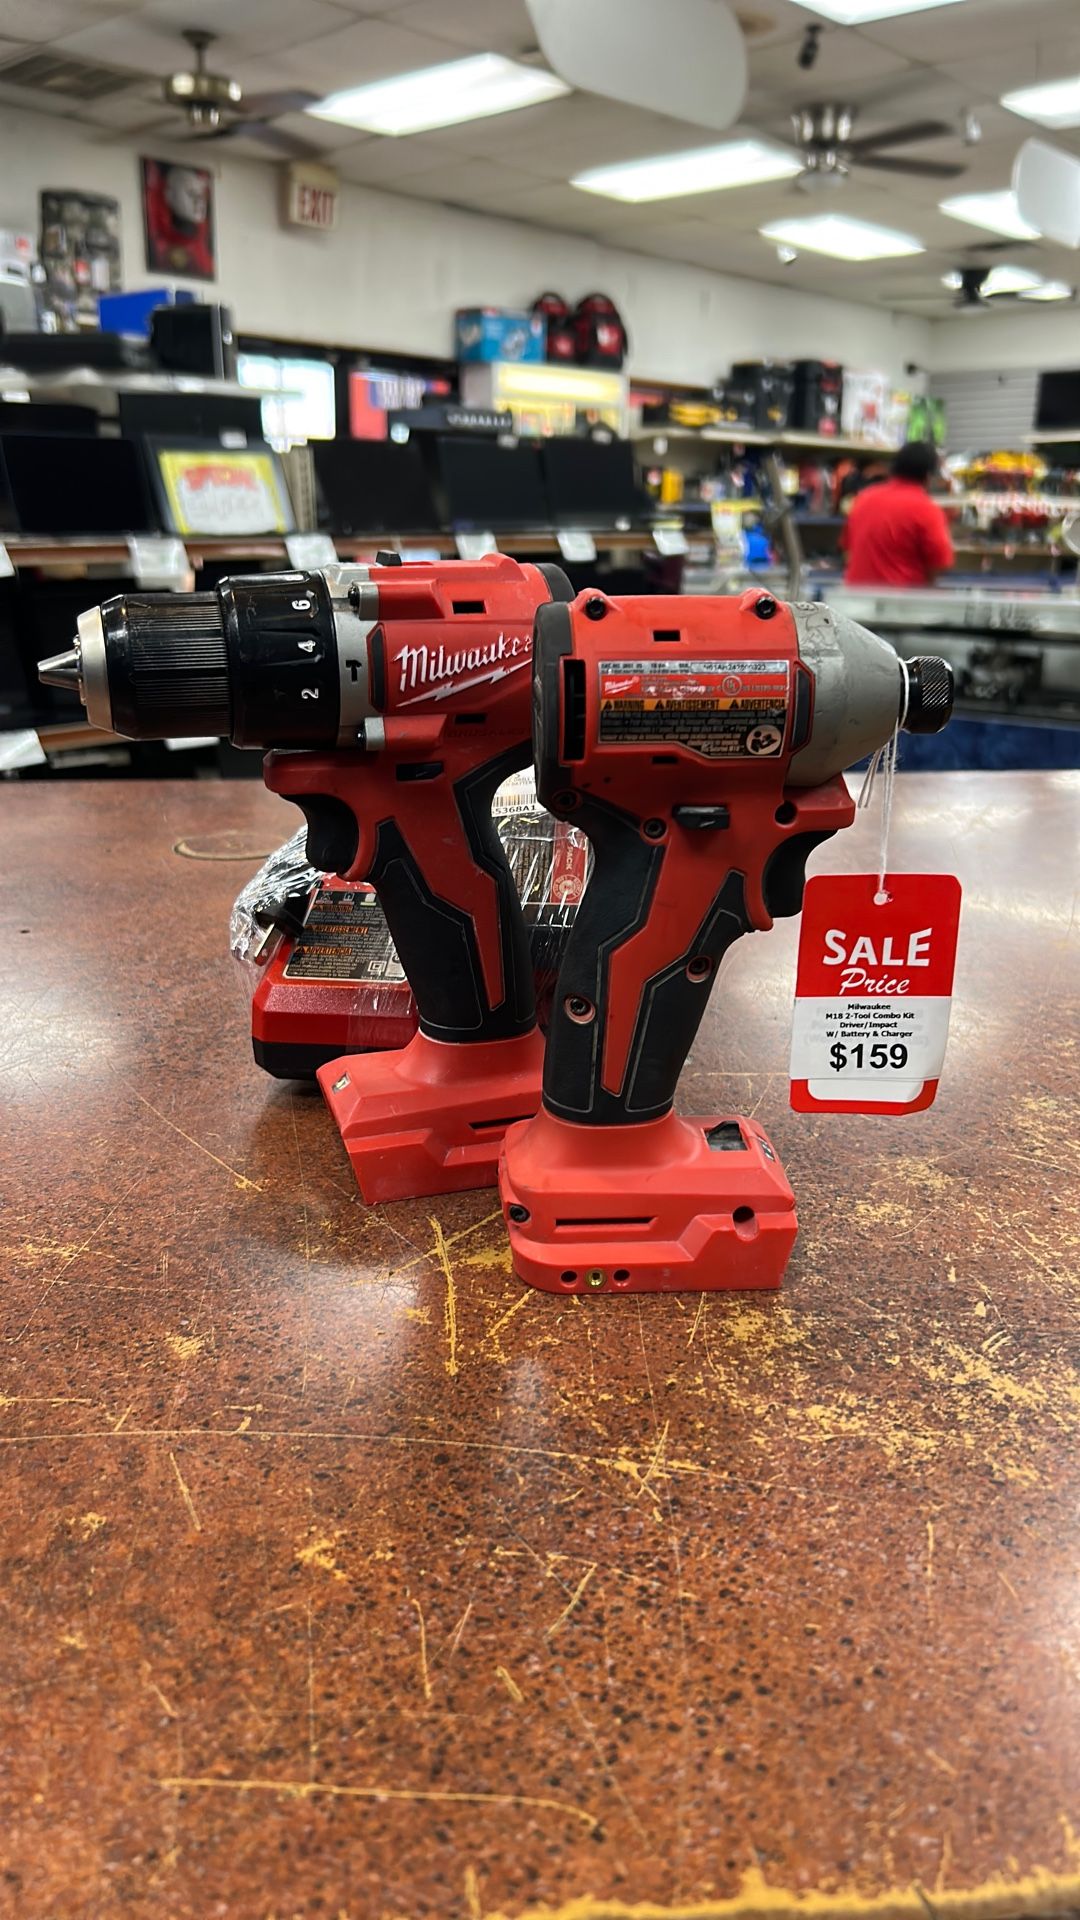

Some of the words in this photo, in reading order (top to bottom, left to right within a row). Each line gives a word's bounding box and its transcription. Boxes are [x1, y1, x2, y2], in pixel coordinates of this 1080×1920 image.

[300, 186, 337, 224] EXIT
[292, 600, 311, 611] 6
[297, 639, 316, 653] 4
[393, 632, 533, 692] Milwaukee
[301, 688, 319, 700] 2
[493, 804, 537, 816] 5368A1
[822, 928, 933, 967] SALE
[838, 967, 911, 995] Price
[825, 1012, 843, 1020] M18
[839, 1021, 898, 1029] Driver/Impact
[841, 1030, 871, 1038] Battery
[881, 1030, 913, 1038] Charger
[829, 1041, 909, 1072] $159
